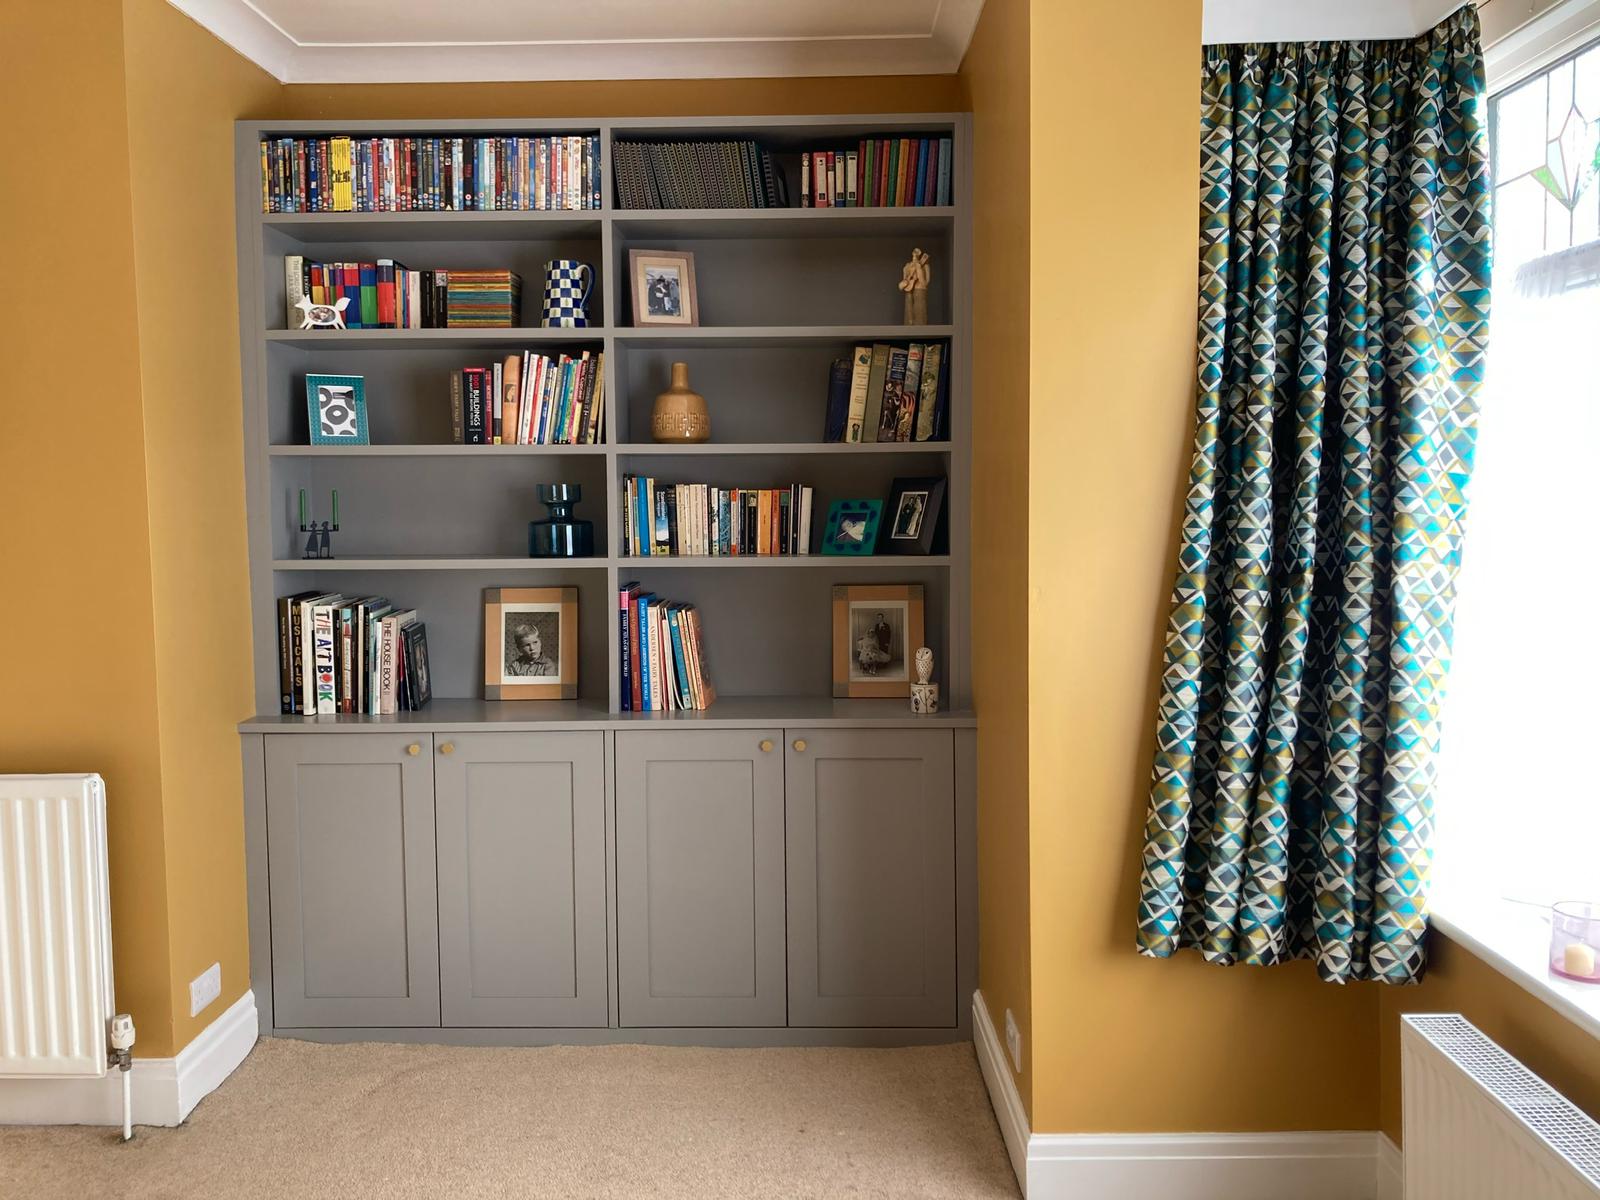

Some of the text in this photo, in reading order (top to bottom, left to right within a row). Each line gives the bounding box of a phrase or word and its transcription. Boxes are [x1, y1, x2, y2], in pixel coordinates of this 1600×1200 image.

[293, 606, 302, 687] MUSICALS
[316, 611, 333, 701] THE ART BOOK
